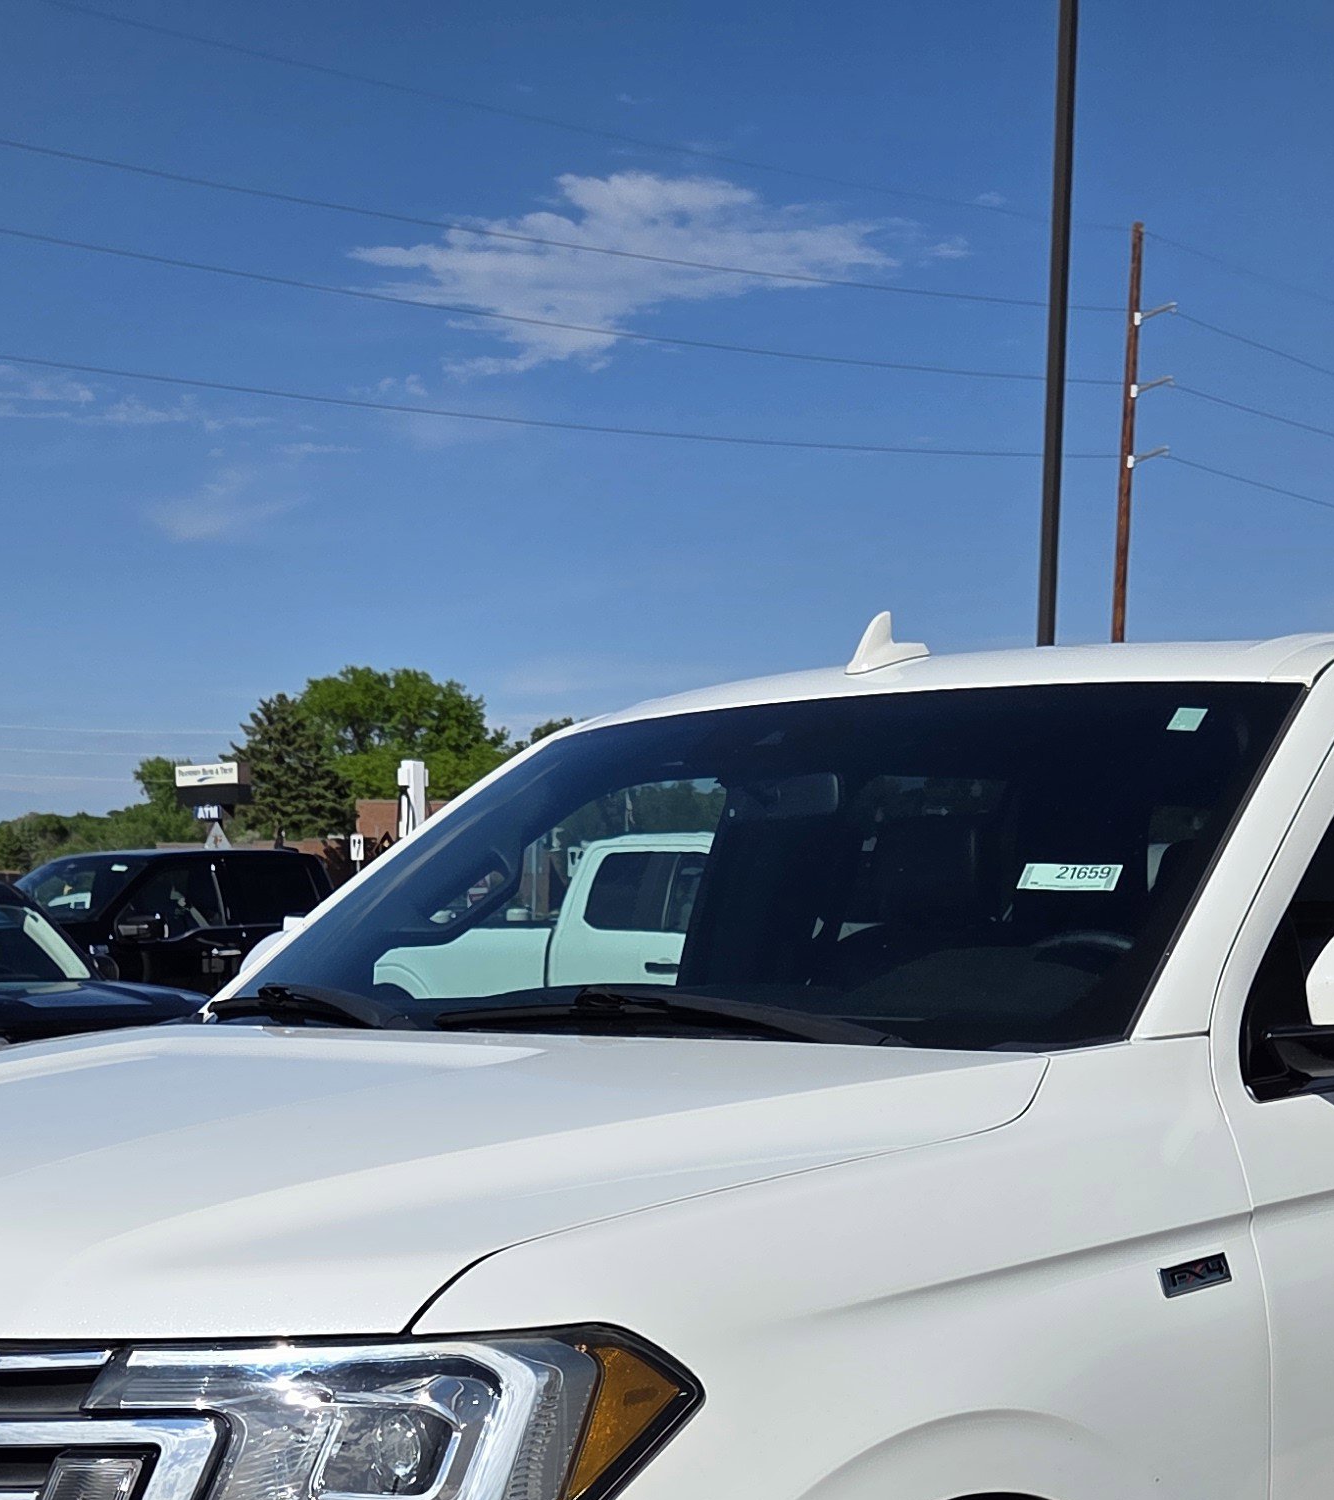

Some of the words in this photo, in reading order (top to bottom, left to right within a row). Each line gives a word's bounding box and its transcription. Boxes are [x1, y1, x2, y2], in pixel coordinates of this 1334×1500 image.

[197, 805, 219, 819] ATM
[1055, 866, 1112, 880] 21659
[1169, 1259, 1226, 1288] FX4
